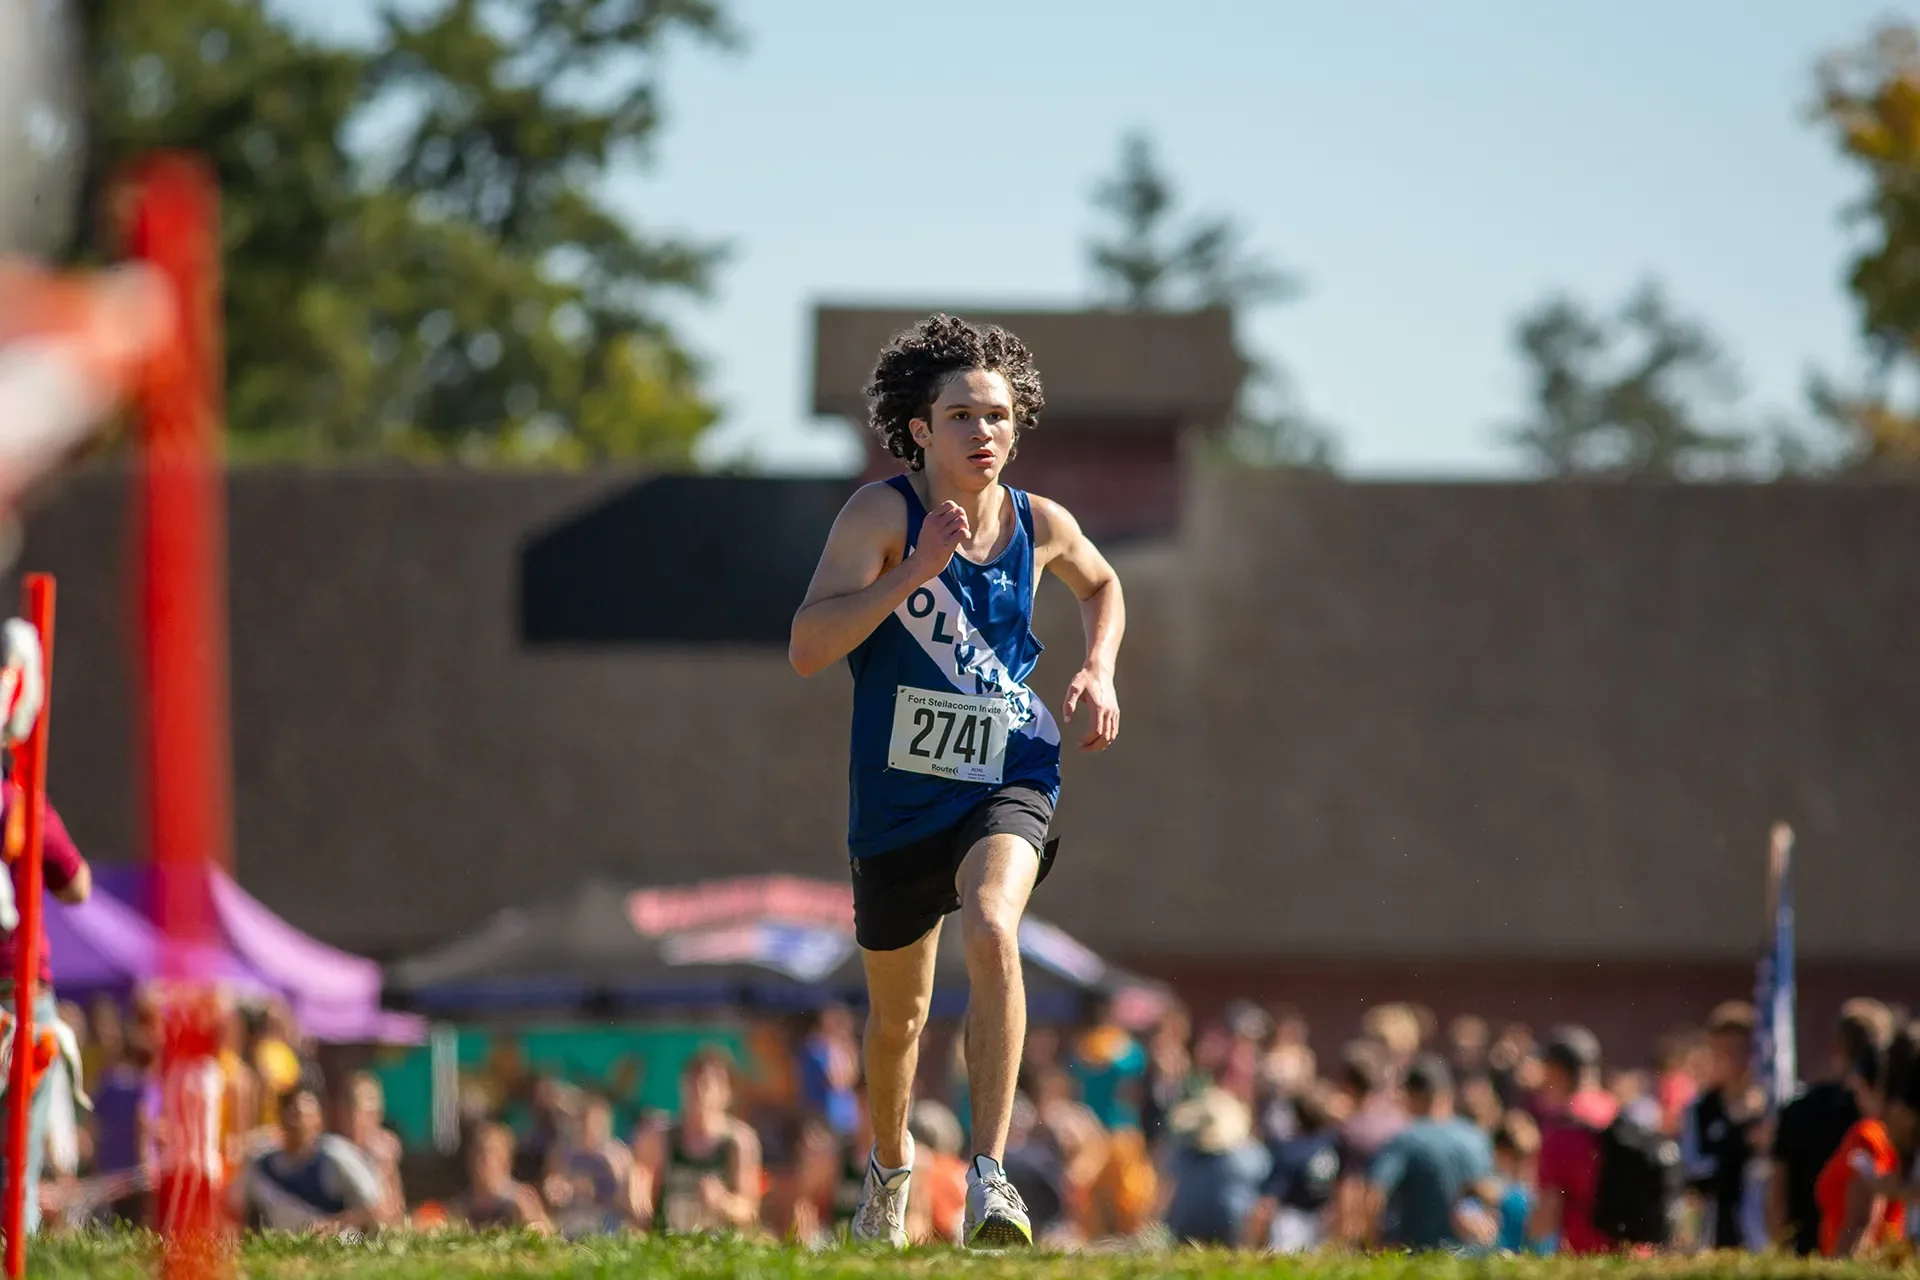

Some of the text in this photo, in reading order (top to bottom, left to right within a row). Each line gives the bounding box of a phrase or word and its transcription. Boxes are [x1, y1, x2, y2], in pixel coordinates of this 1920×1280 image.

[907, 694, 1002, 714] Fort Steilacoom Invite
[909, 708, 992, 765] 2741
